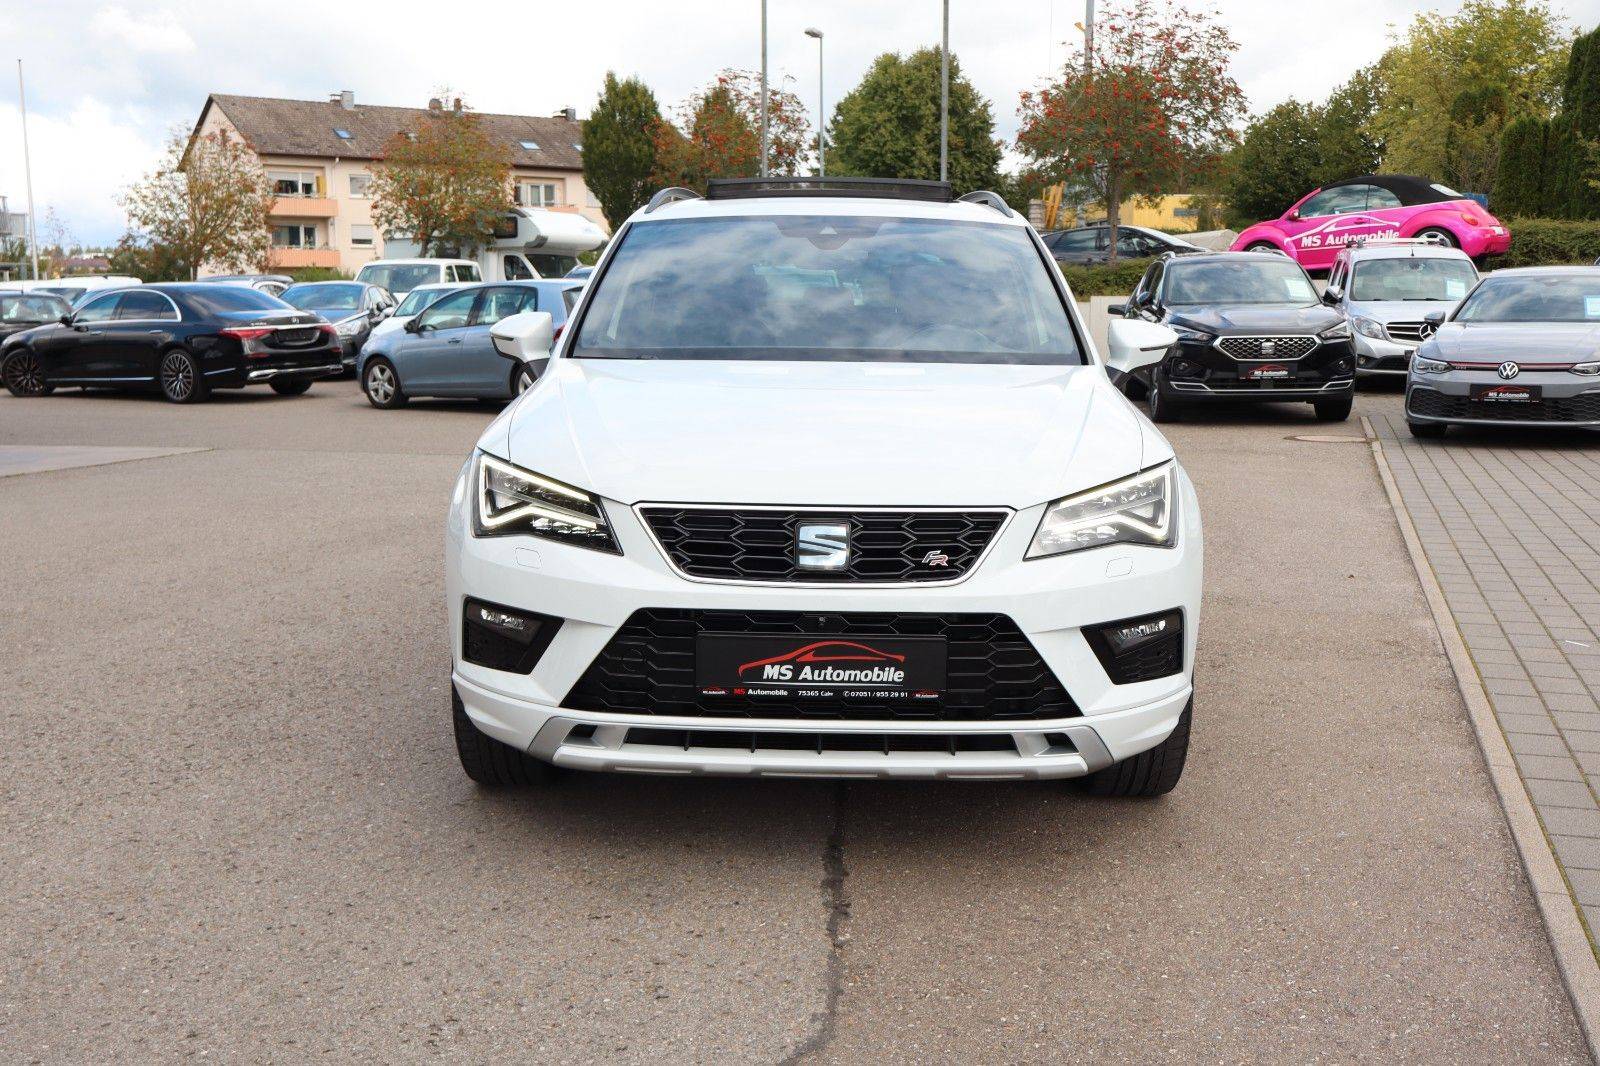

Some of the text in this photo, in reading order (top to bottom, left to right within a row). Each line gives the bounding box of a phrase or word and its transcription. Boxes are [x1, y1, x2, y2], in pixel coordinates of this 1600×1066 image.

[1301, 235, 1321, 248] MS
[763, 664, 905, 682] MS Automobile
[733, 688, 746, 696] MS
[747, 688, 789, 696] Automobile
